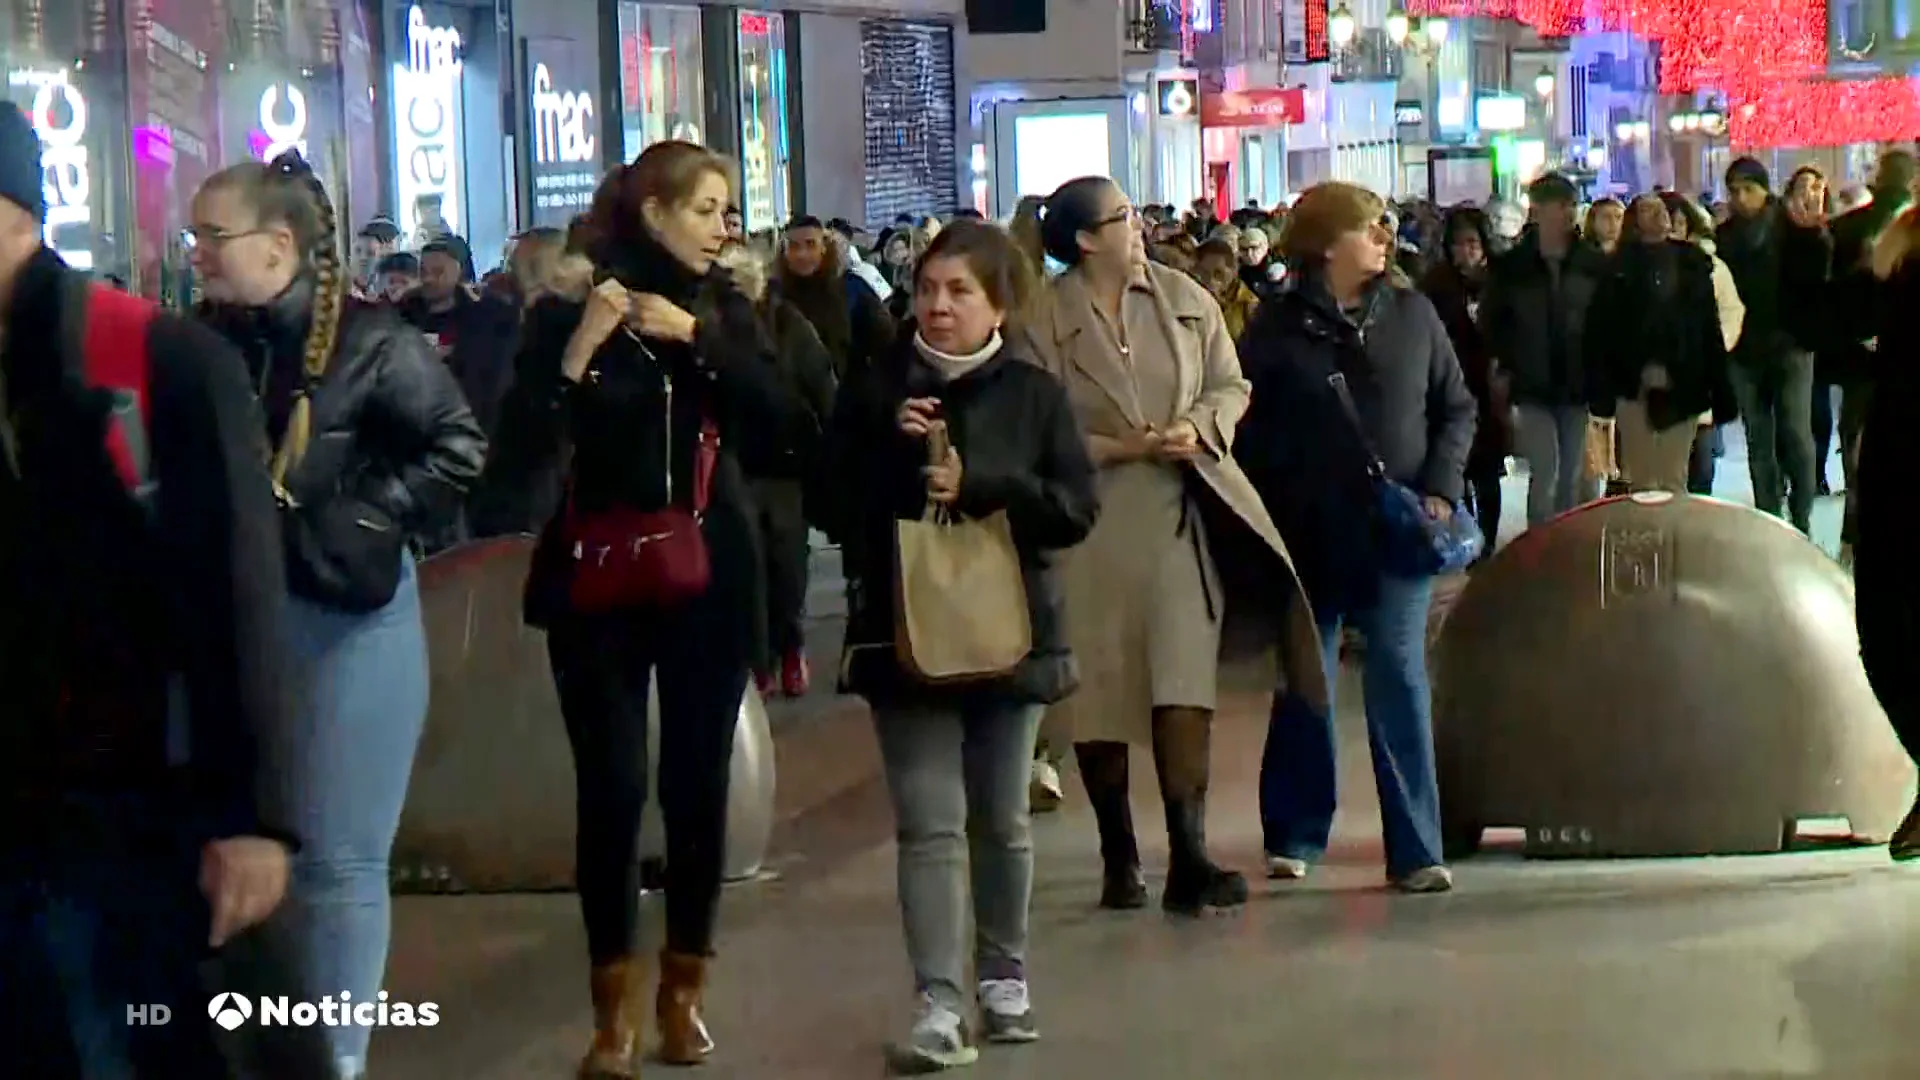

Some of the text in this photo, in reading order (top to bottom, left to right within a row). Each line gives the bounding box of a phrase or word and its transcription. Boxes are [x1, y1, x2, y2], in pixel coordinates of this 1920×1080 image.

[408, 4, 462, 76] fnac
[533, 63, 594, 161] fnac
[33, 82, 92, 269] nac
